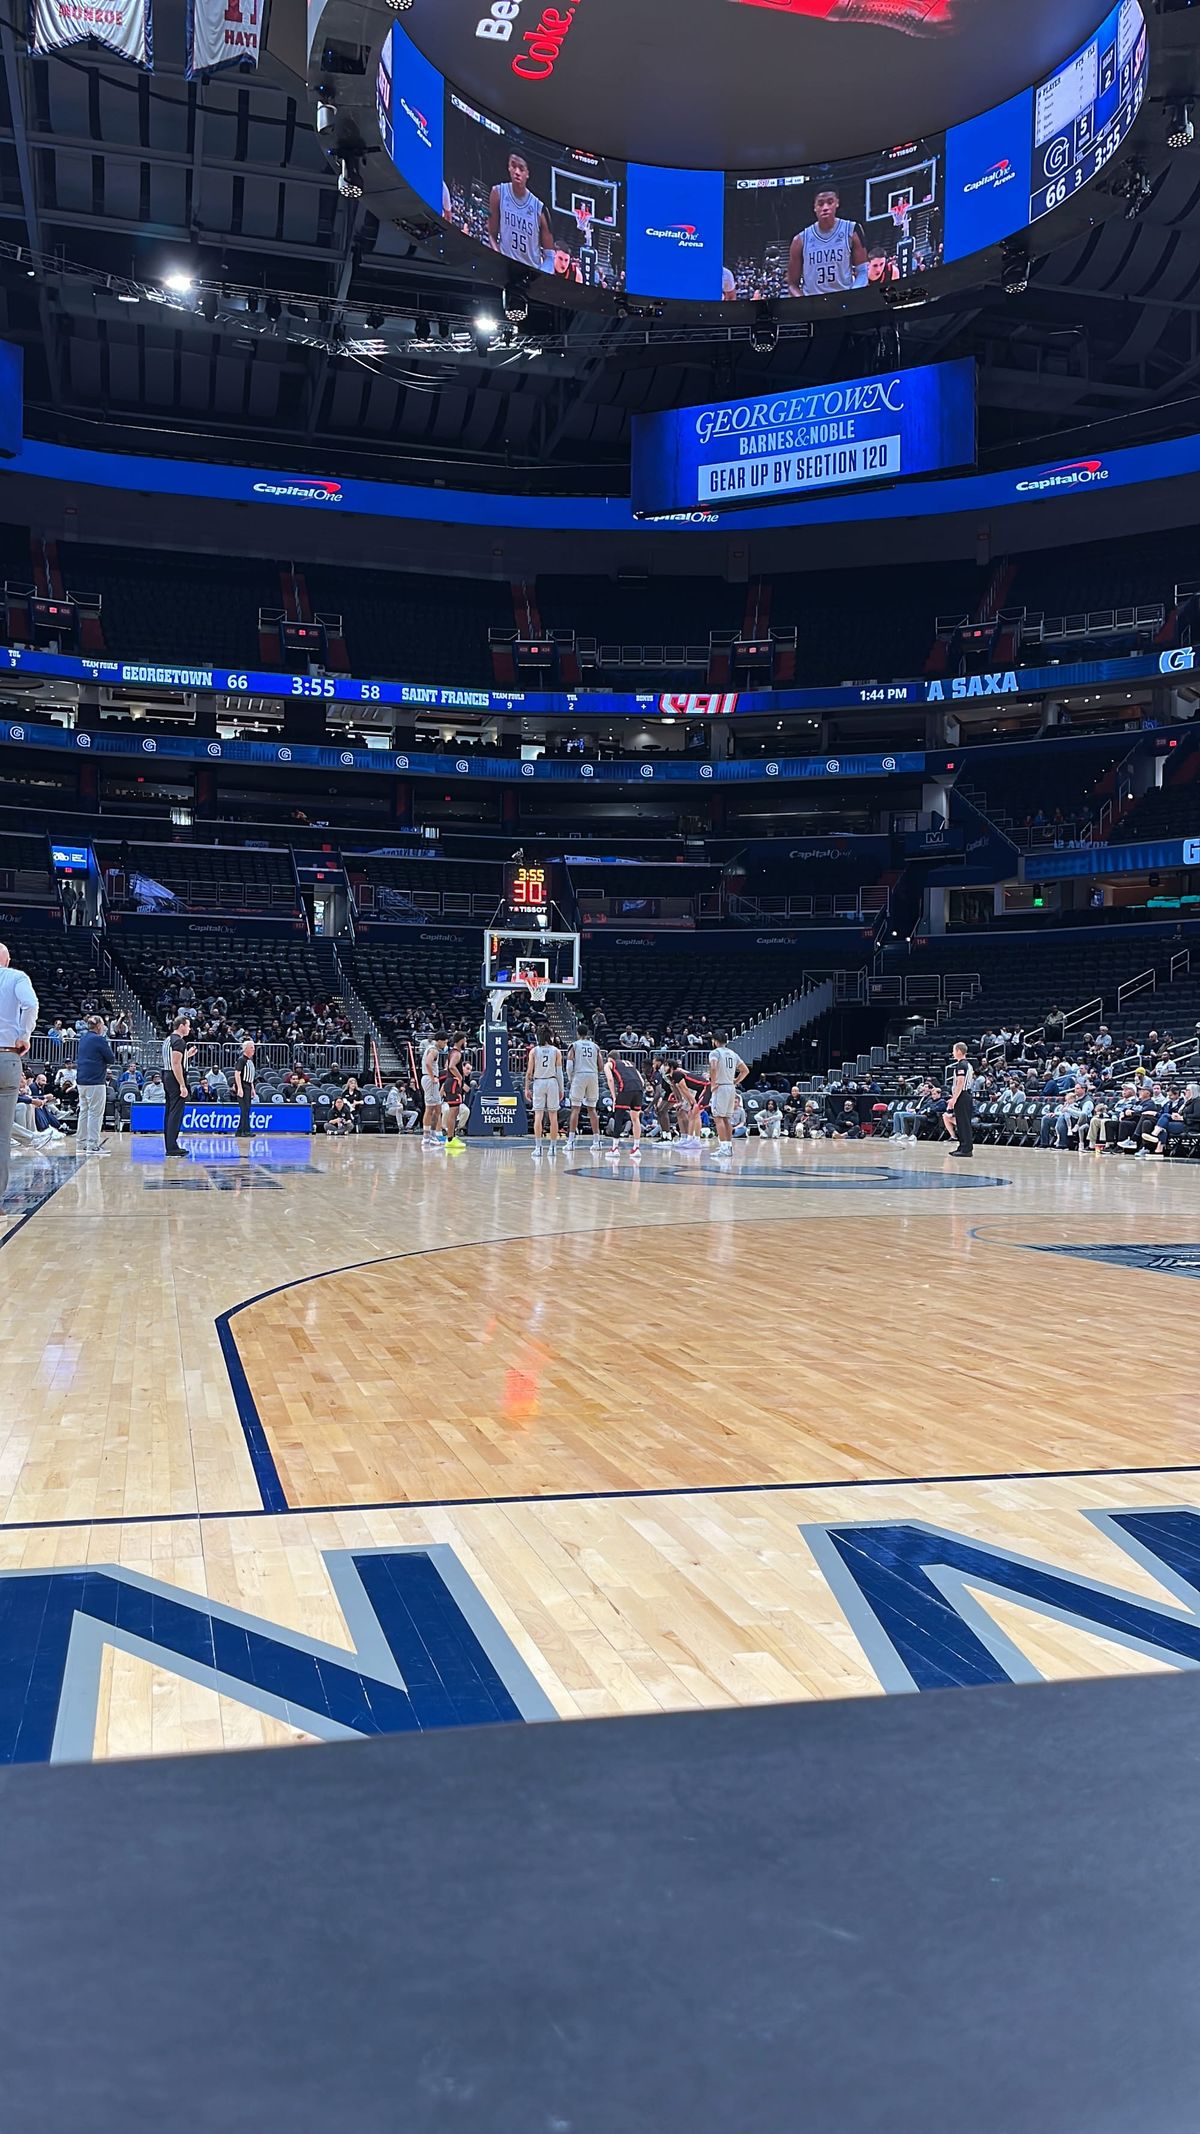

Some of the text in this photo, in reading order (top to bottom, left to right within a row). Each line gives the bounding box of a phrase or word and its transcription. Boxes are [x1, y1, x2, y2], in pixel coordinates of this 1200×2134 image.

[1045, 177, 1066, 208] 66
[504, 210, 534, 237] HOYAS
[511, 231, 527, 254] 35
[678, 239, 704, 248] Arena
[808, 248, 844, 266] HOYAS
[817, 265, 836, 285] 35
[696, 378, 904, 444] GEORGETOWN
[710, 444, 888, 493] GEAR UP BY SECTION 120
[10, 658, 17, 667] 3
[122, 665, 490, 706] GEORGETOWN 66 3:55 58 SAINT FRANCIS
[952, 671, 1019, 699] SAXA
[860, 687, 907, 701] 1:44 PM
[506, 701, 513, 709] 9
[568, 702, 574, 710] 2
[518, 869, 544, 882] 3:55
[513, 881, 543, 904] 30
[520, 906, 547, 914] TISSOT
[581, 1046, 593, 1058] 35
[542, 1055, 549, 1068] 2
[725, 1057, 733, 1069] 10
[481, 1106, 517, 1115] MedStar
[182, 1108, 273, 1129] cketmater
[484, 1115, 514, 1124] Health
